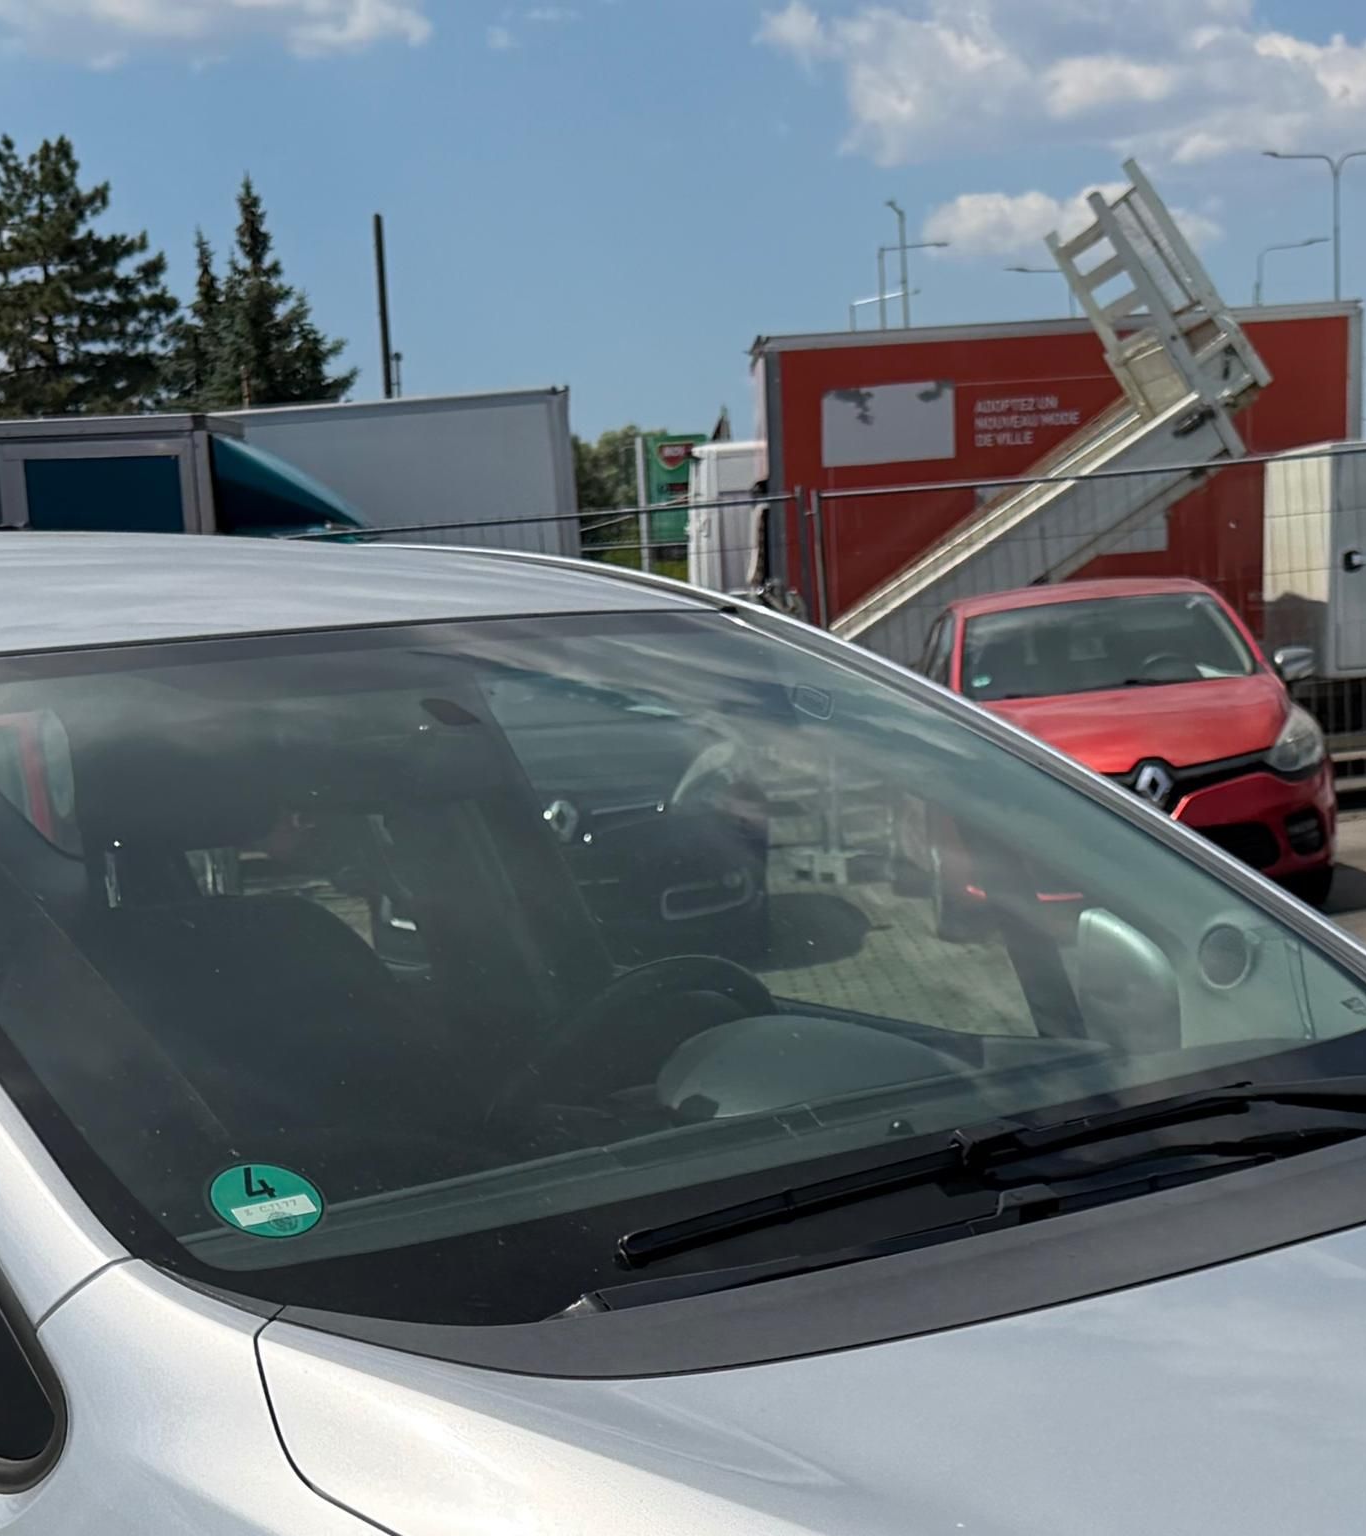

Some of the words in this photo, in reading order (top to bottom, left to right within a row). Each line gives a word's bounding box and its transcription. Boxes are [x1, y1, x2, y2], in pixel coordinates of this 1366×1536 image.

[976, 432, 994, 447] DE
[995, 430, 1033, 445] VILLE
[243, 1166, 277, 1198] 4
